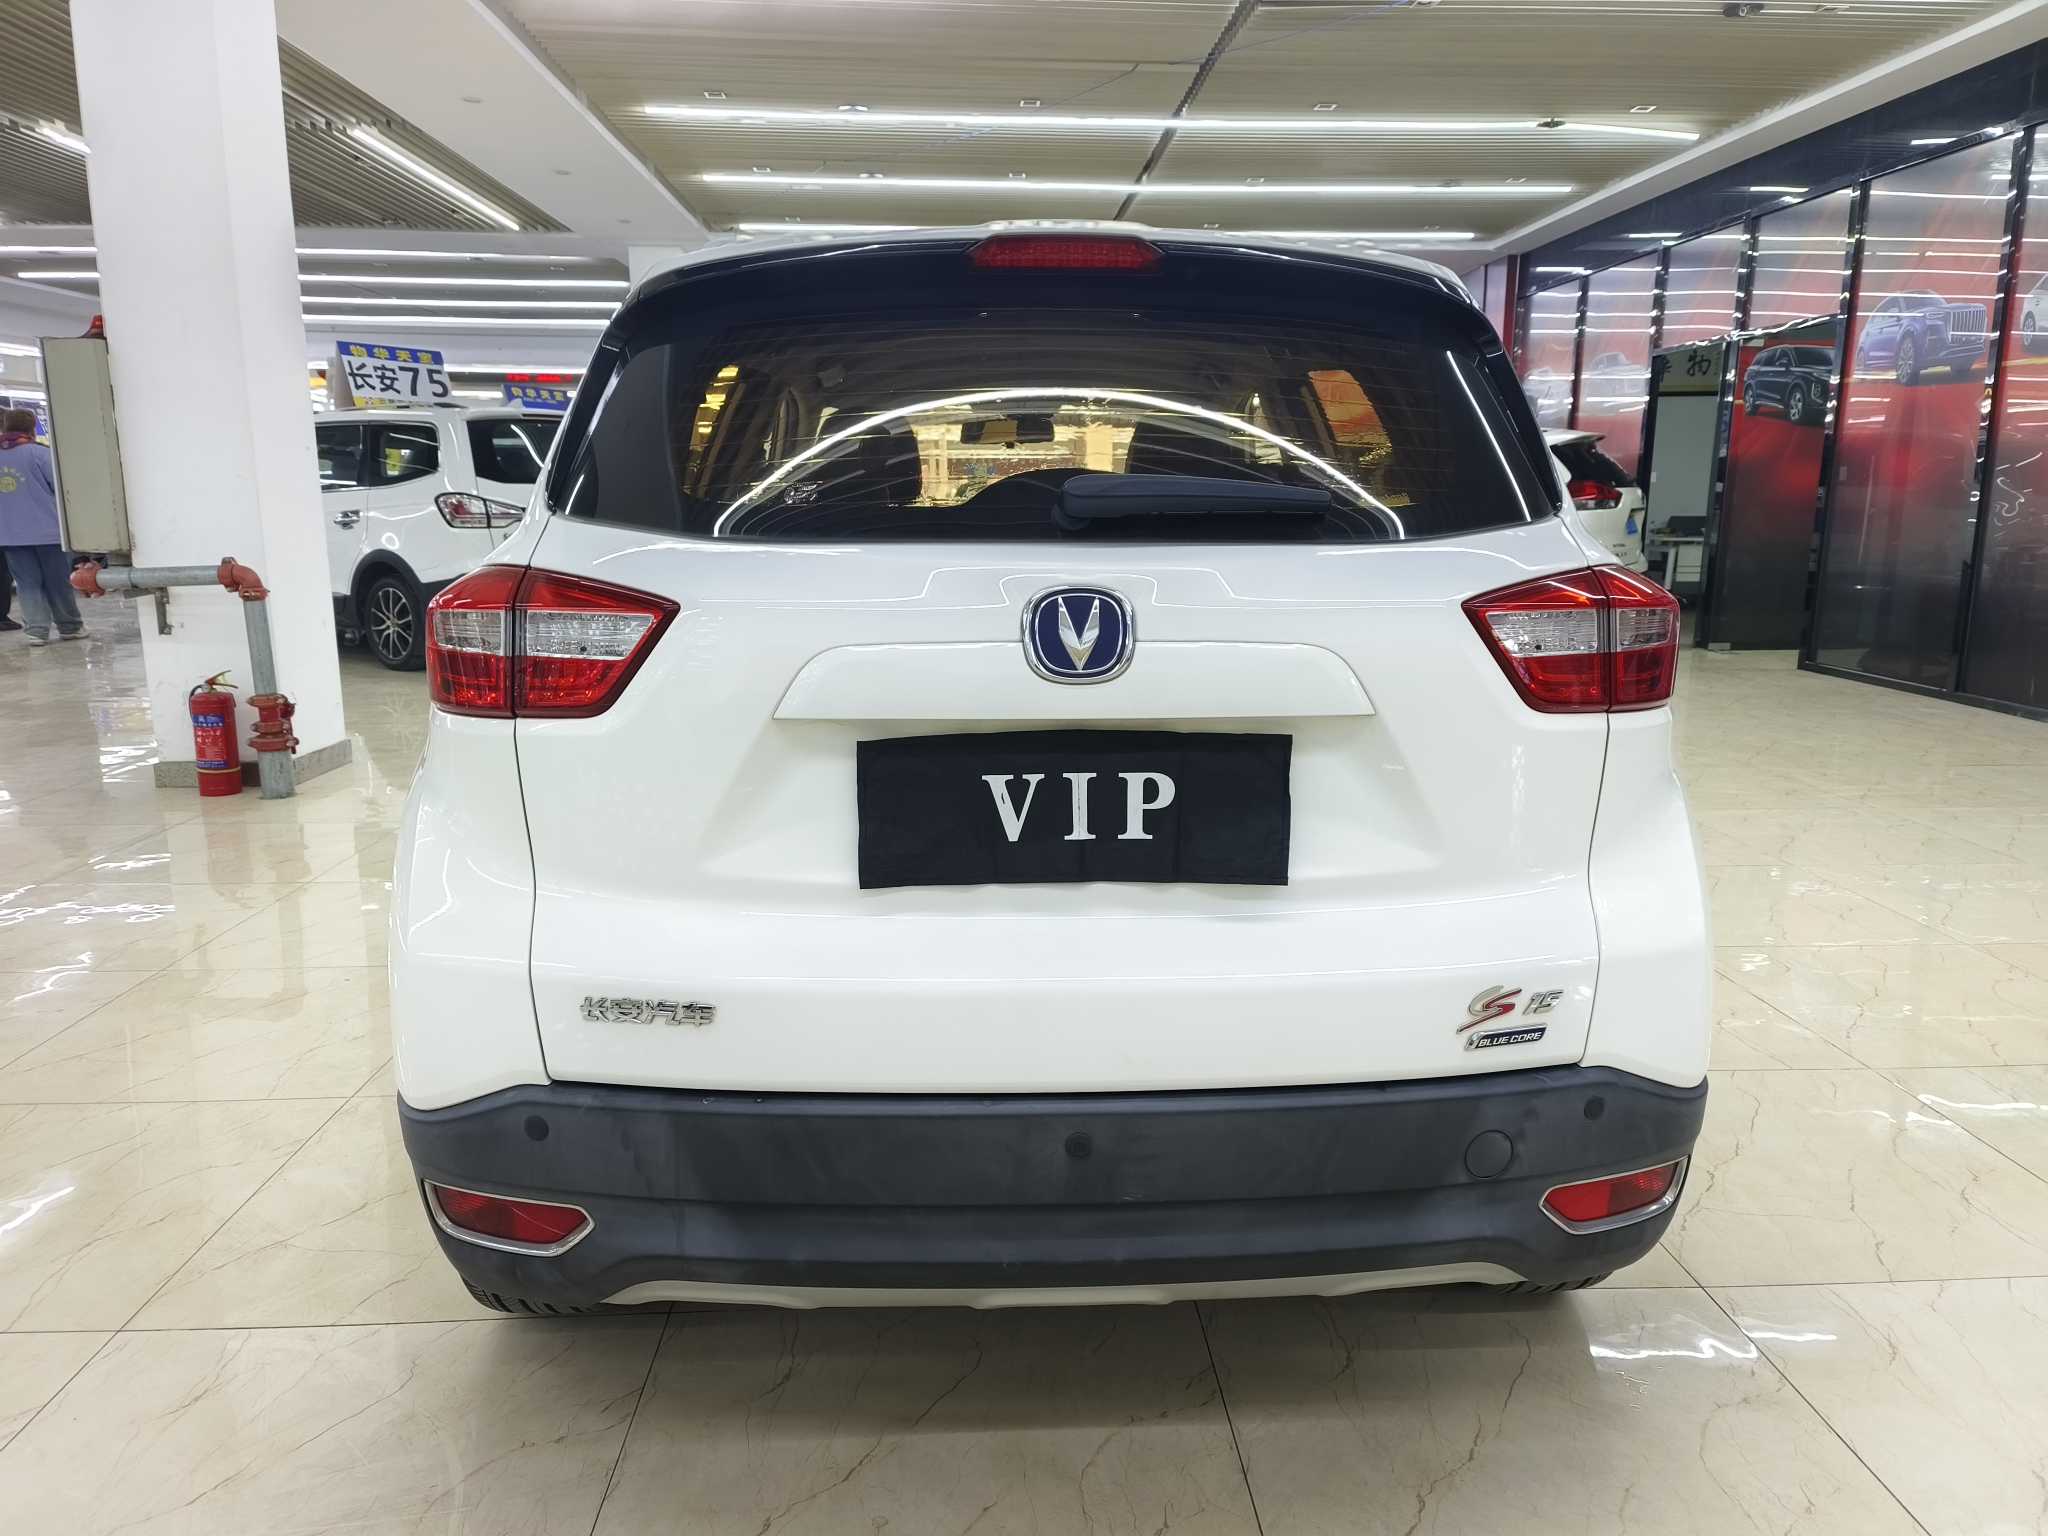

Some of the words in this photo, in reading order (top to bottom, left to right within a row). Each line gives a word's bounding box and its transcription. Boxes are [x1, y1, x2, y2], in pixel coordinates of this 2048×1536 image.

[347, 360, 449, 398] 长安75
[981, 771, 1177, 843] VIP
[579, 996, 717, 1027] 长安汽车
[1478, 1036, 1510, 1048] BLUE
[1510, 1031, 1543, 1044] CORE
